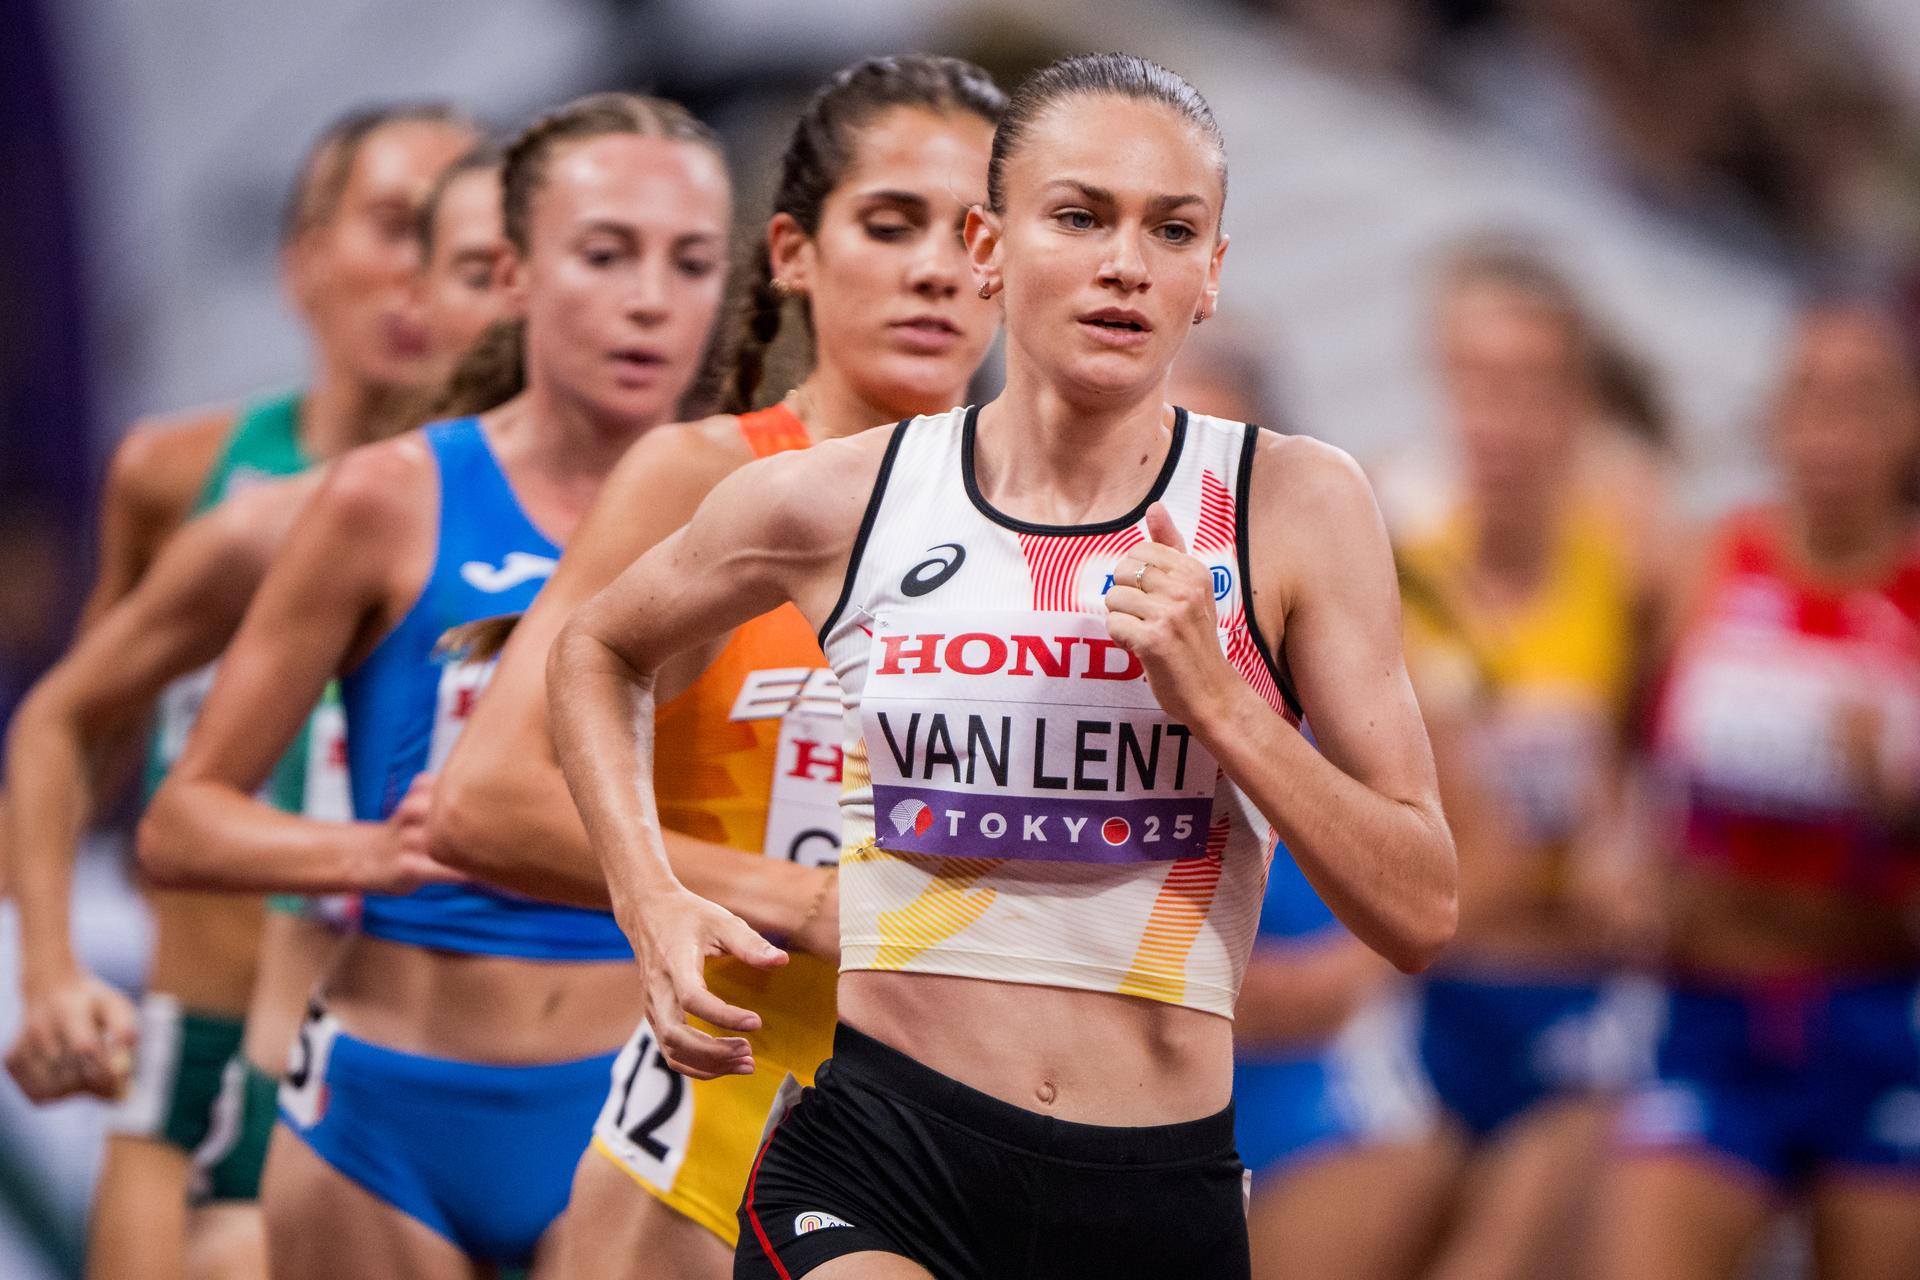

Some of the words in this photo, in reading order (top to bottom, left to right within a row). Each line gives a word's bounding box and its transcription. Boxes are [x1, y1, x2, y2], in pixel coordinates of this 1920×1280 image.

[875, 632, 1148, 683] HOND
[876, 711, 1012, 787] VAN
[1032, 717, 1193, 793] LENT
[614, 1033, 686, 1164] 12
